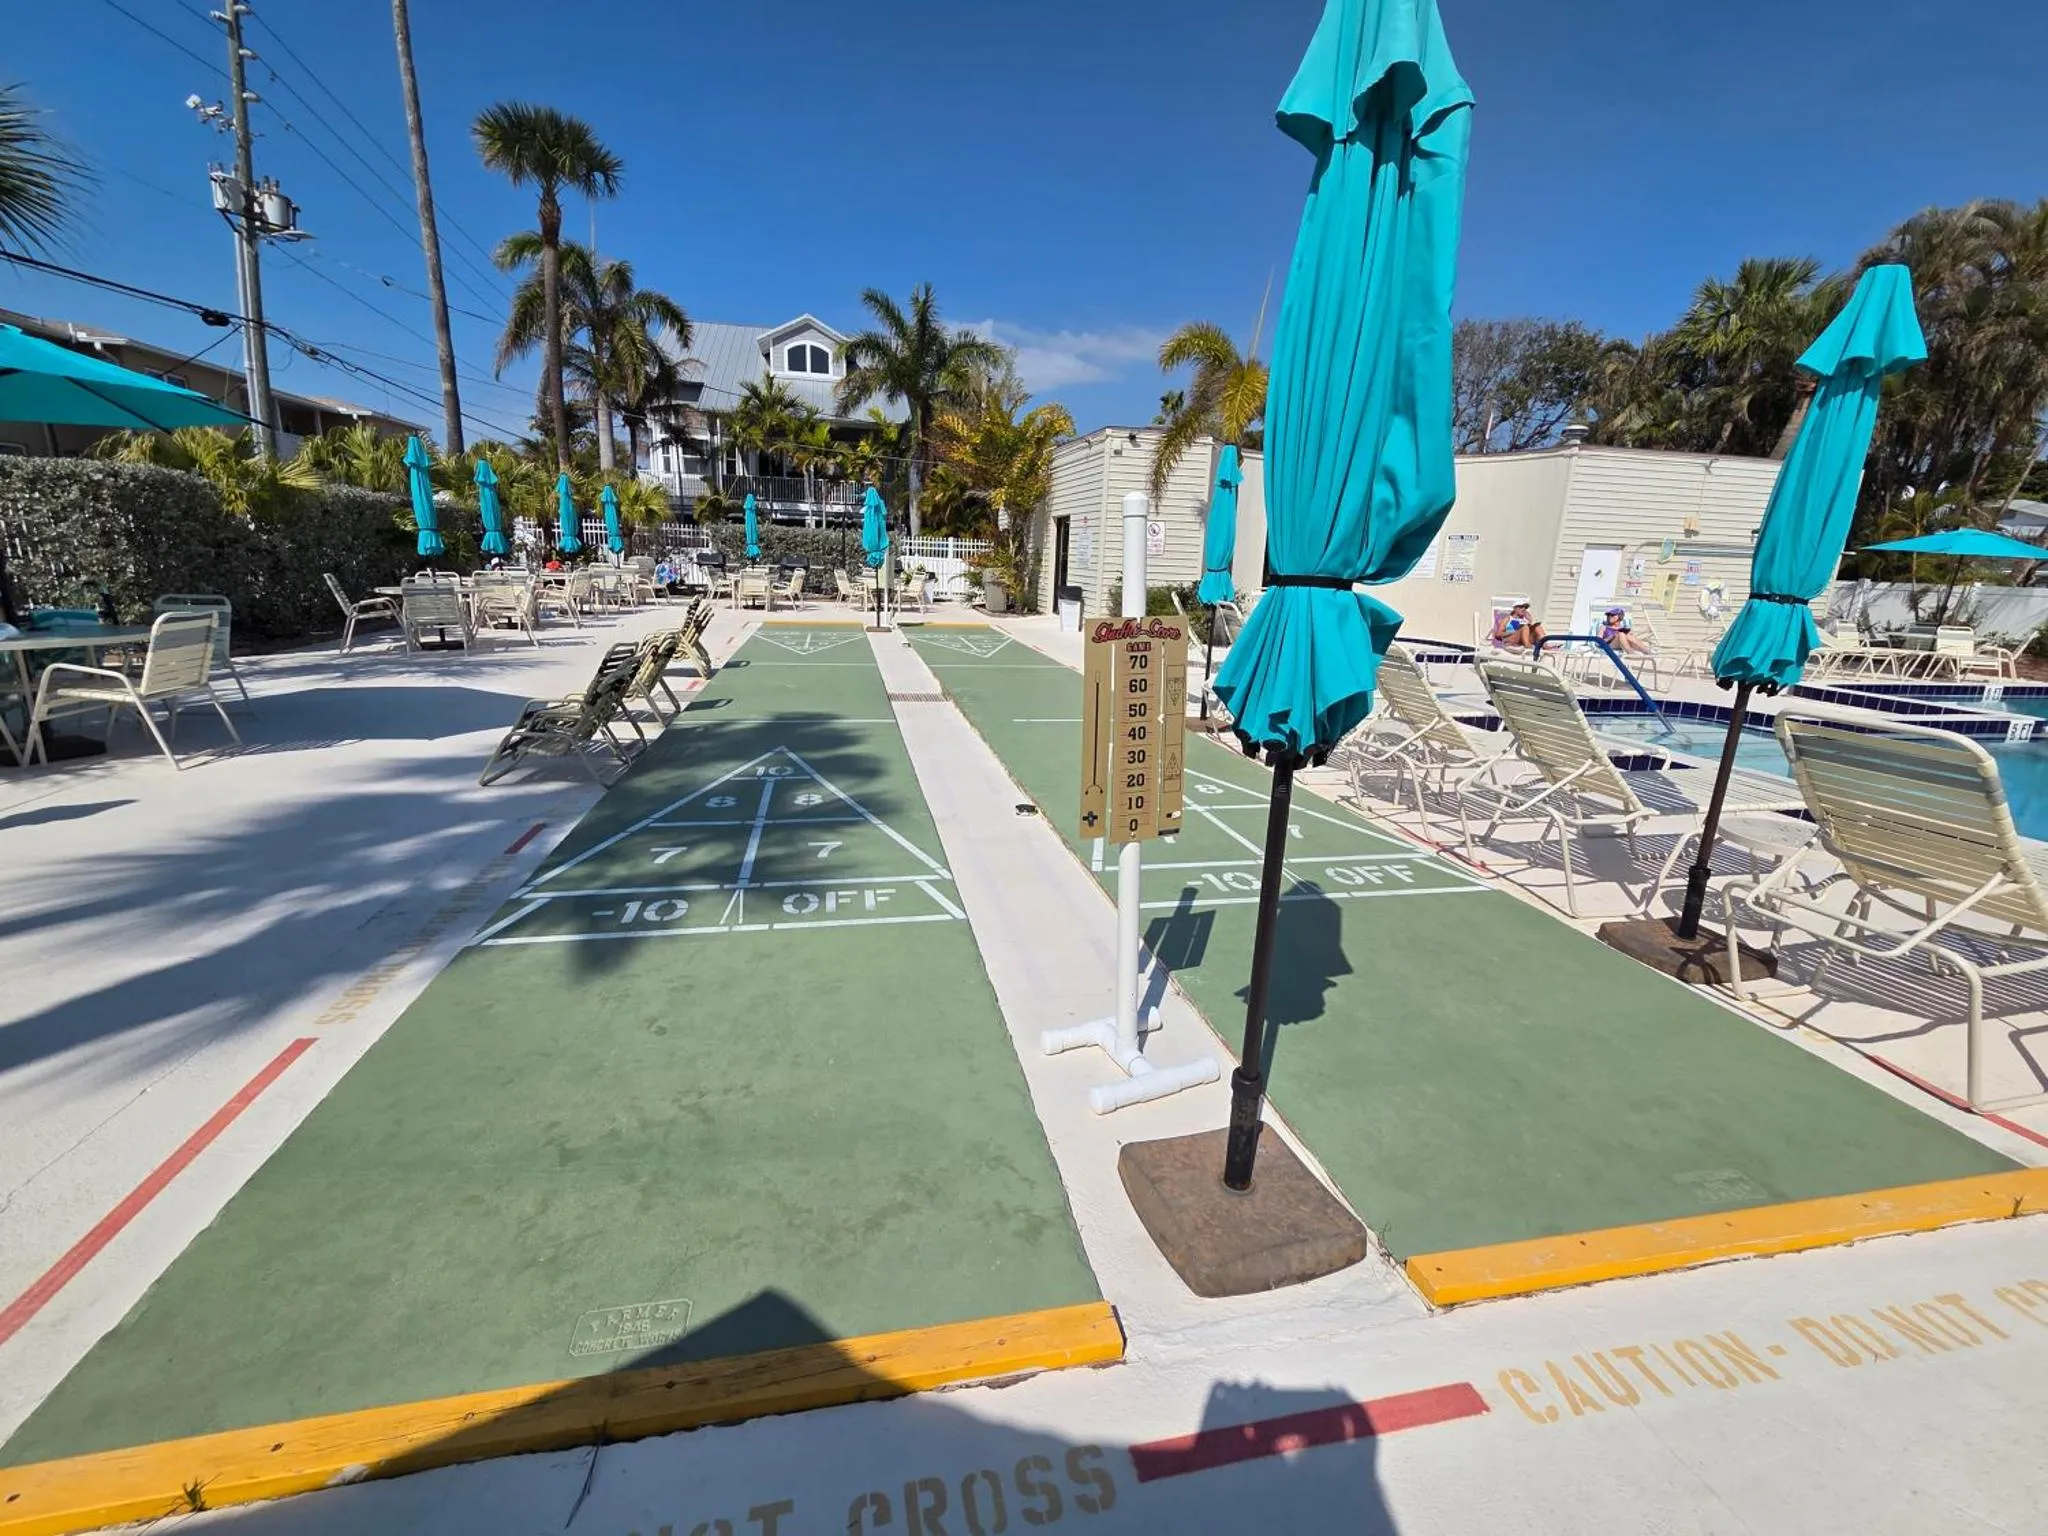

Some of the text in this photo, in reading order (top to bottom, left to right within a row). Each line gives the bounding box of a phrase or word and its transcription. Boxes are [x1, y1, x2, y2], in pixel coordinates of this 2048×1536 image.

[1126, 642, 1152, 652] GAME
[1129, 655, 1148, 669] 70
[1129, 679, 1148, 693] 60
[1128, 703, 1147, 717] 50
[1127, 726, 1146, 740] 40
[2009, 723, 2033, 740] 5 FT
[1127, 750, 1146, 764] 30
[755, 765, 795, 777] 10
[1126, 773, 1145, 787] 20
[1193, 784, 1224, 795] 8
[706, 793, 825, 808] 8 8
[1127, 796, 1144, 810] 10
[1129, 819, 1138, 831] 0
[650, 841, 843, 864] 7 7
[1325, 864, 1416, 885] OFF
[591, 888, 897, 924] -10 OFF
[1789, 1314, 1902, 1368] DO
[1870, 1292, 2010, 1355] NOT
[848, 1445, 1116, 1536] CROSS
